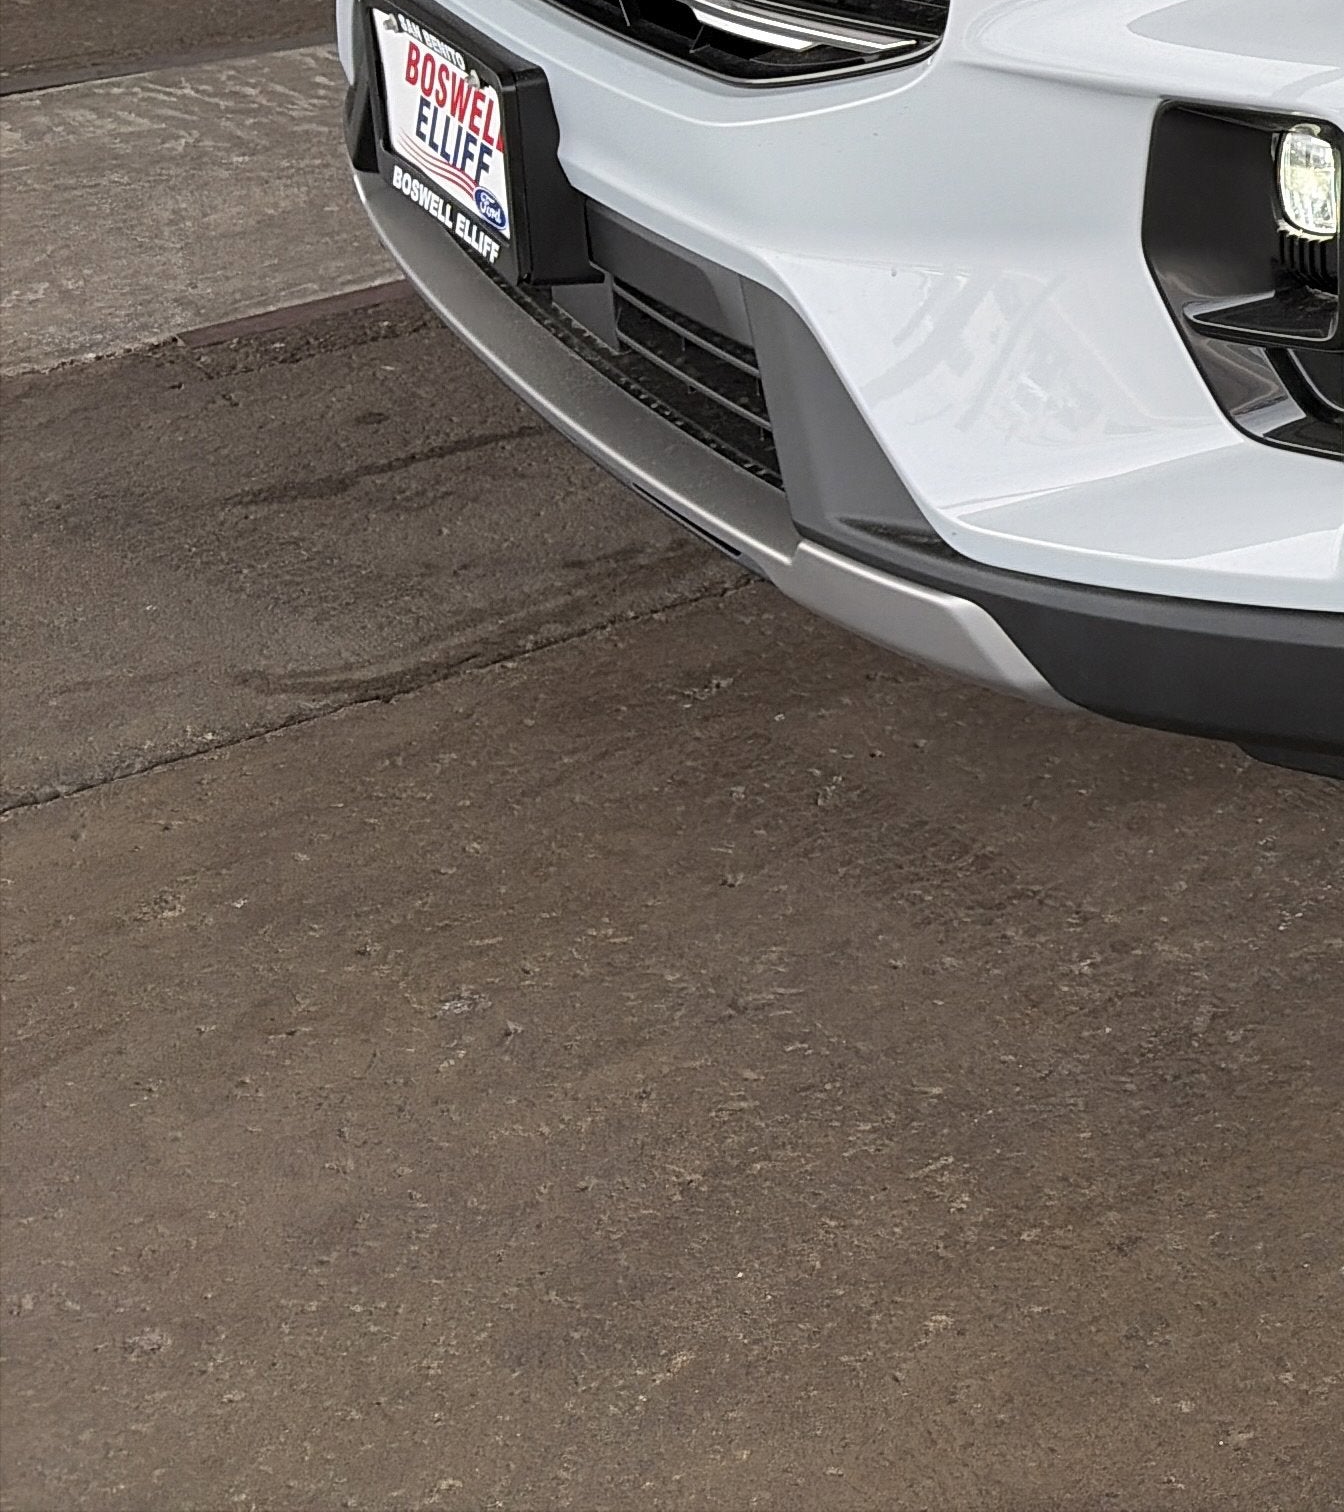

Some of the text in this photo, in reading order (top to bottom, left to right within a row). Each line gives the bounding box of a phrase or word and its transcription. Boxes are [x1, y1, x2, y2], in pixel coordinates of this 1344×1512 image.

[397, 13, 466, 71] SAN BENITO
[415, 95, 493, 185] ELLIFF
[392, 165, 501, 265] BOSWELL ELLIFF
[479, 191, 503, 225] Ford
